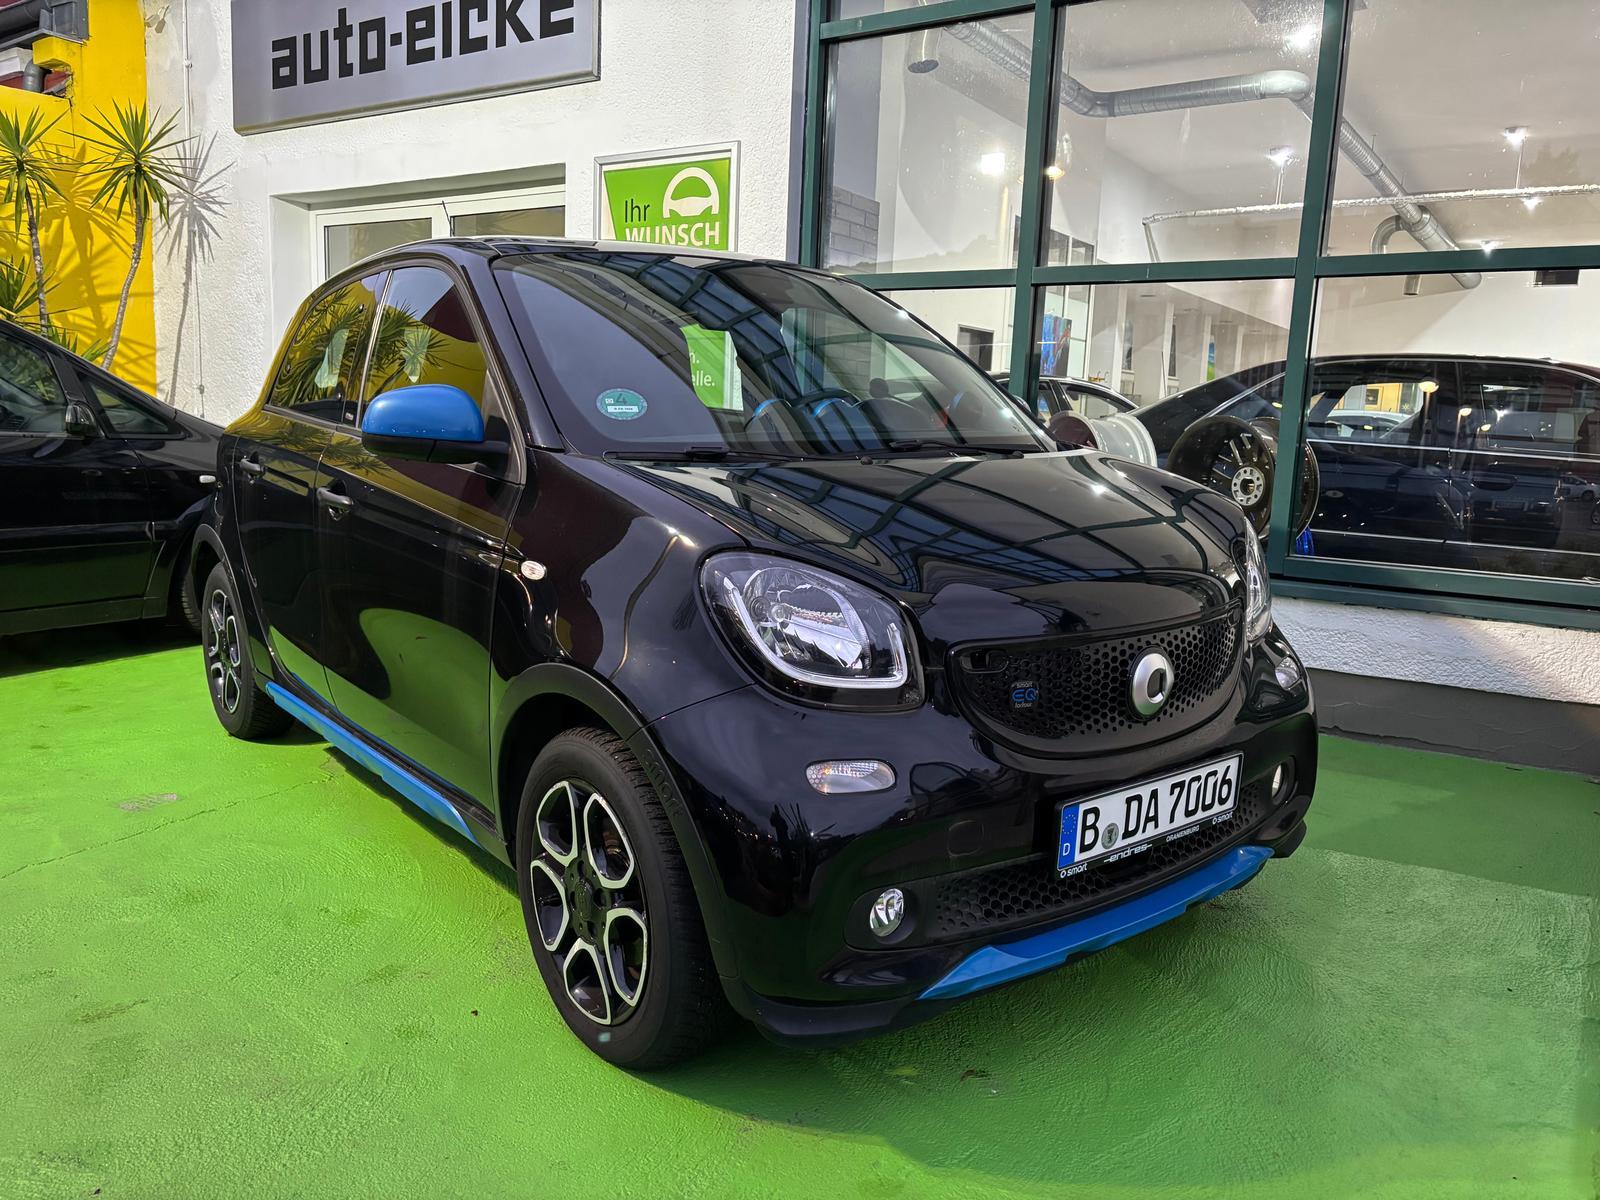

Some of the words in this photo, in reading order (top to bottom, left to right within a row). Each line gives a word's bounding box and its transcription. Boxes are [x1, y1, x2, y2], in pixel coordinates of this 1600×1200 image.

[625, 199, 650, 223] Ihr
[625, 222, 720, 246] WUNSCH
[1011, 687, 1036, 703] EQ
[1079, 807, 1101, 854] B
[1121, 788, 1160, 840] DA
[1169, 765, 1233, 824] 7006
[1216, 811, 1233, 823] smart
[1062, 842, 1071, 856] D
[1066, 862, 1088, 877] smart
